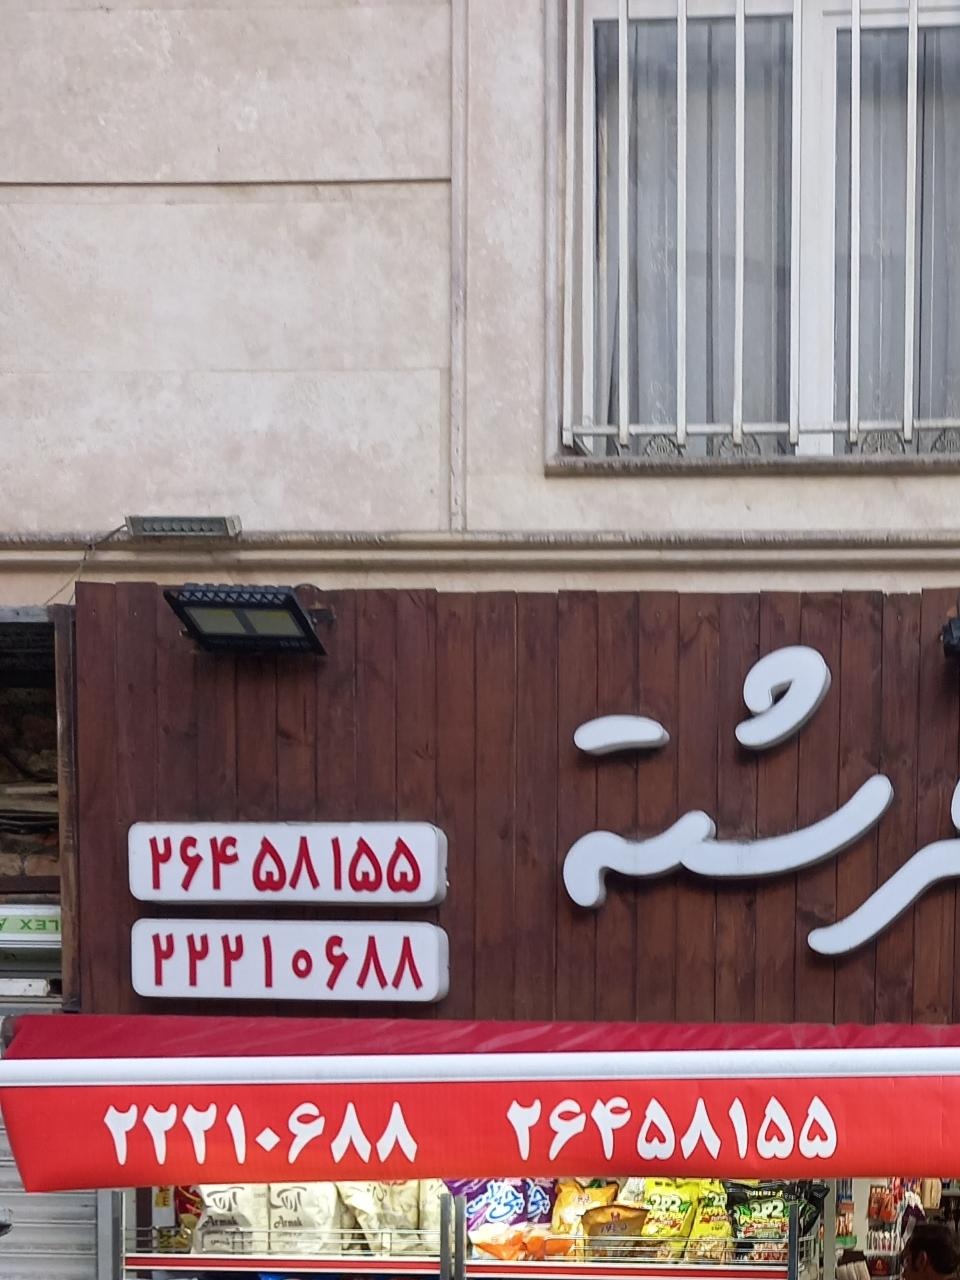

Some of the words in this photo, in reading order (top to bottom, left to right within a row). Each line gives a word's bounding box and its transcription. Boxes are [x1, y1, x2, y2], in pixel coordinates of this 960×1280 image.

[148, 835, 422, 893] ۲۶۴۵۸۱۵۵
[151, 932, 424, 990] ۲۲۲۱۰۶۸۸
[103, 1100, 419, 1165] ۲۲۲۱۰۶۸۸
[506, 1094, 837, 1161] ۲۶۴۵۸۱۵۵
